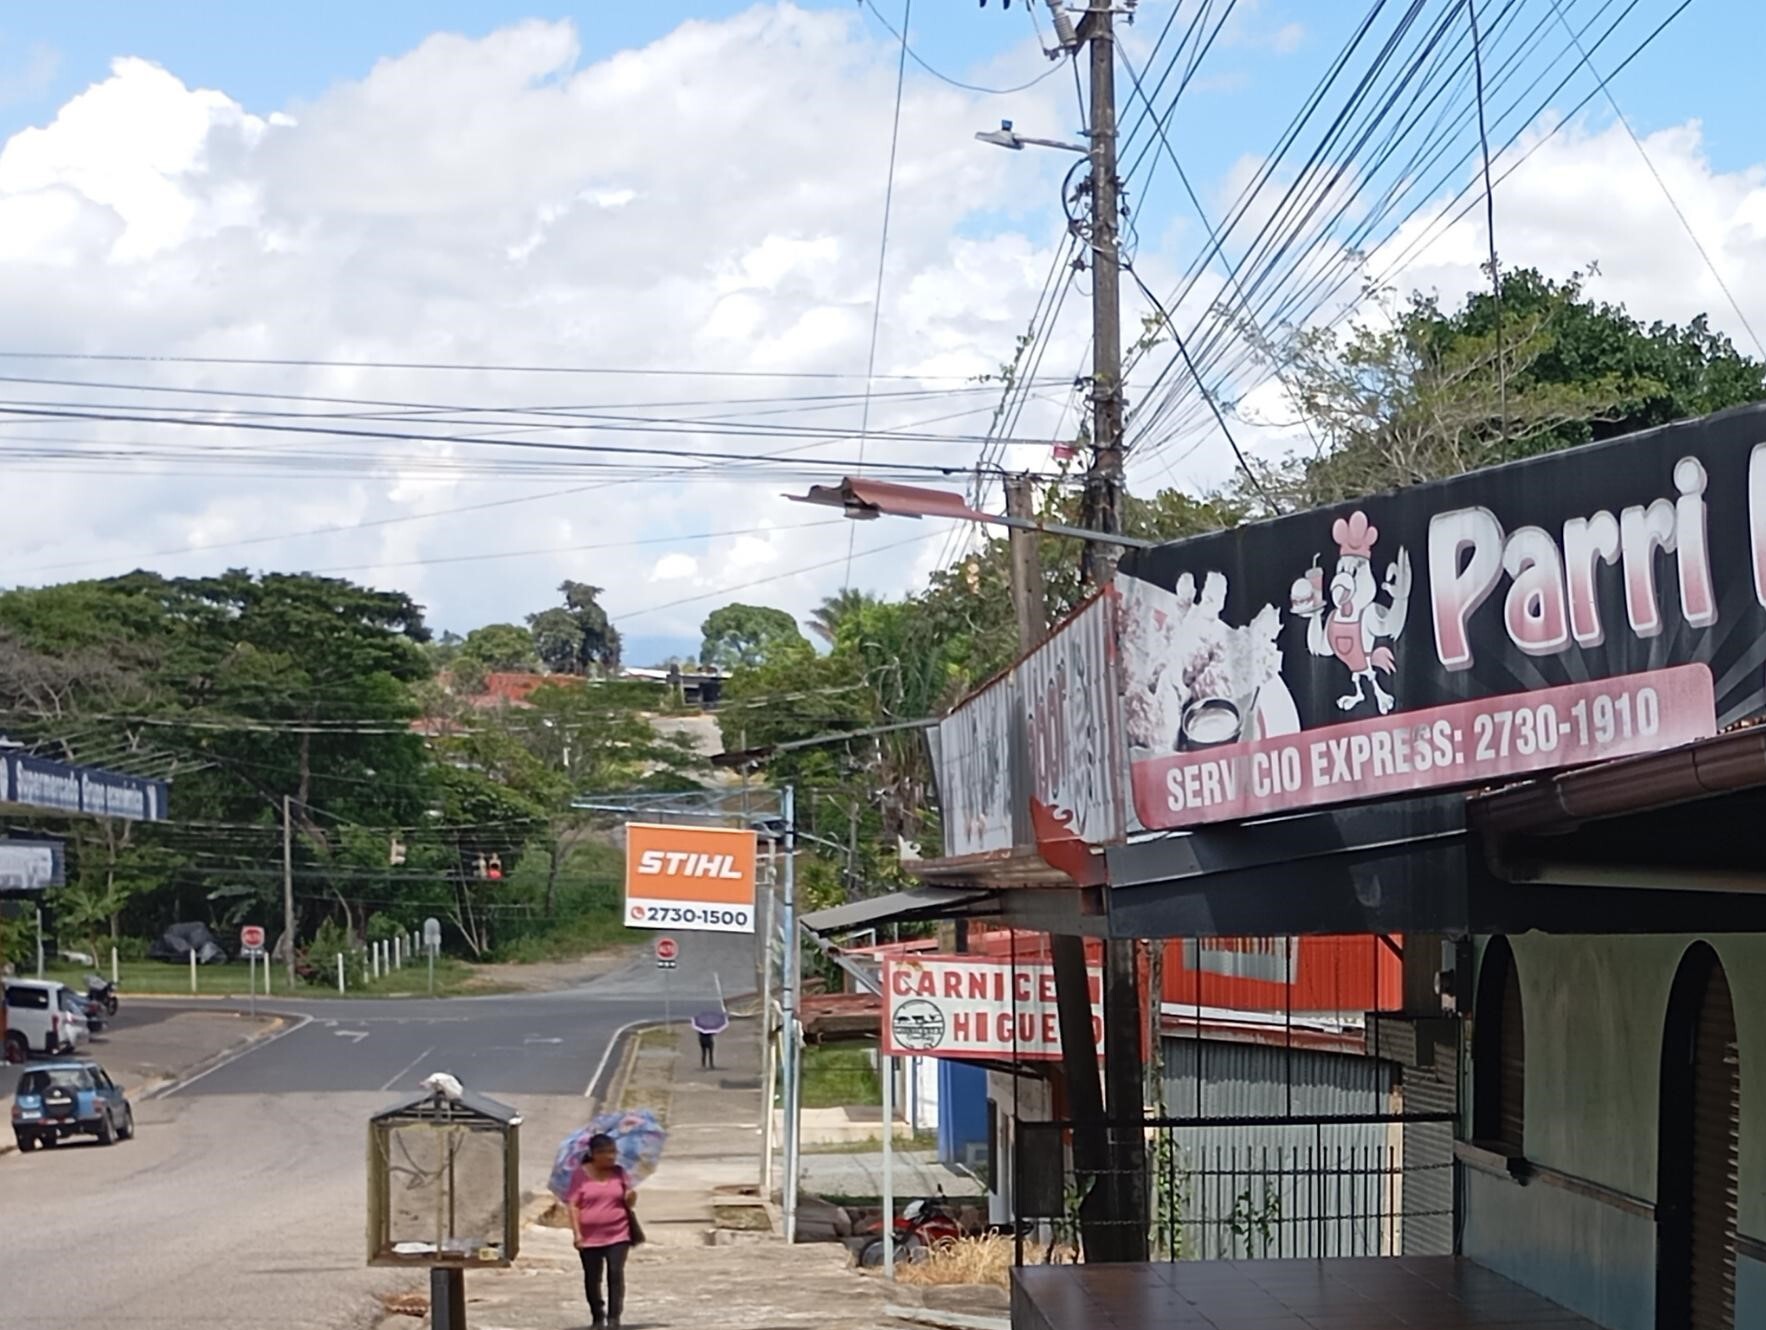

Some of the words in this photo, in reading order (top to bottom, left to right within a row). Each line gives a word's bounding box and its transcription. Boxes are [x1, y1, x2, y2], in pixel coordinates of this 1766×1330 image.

[1428, 456, 1718, 672] Parri
[1167, 746, 1302, 812] SERVCIO
[1310, 719, 1465, 788] EXPRESS:
[1474, 687, 1659, 763] 2730-1910
[637, 850, 743, 879] STIHL
[647, 907, 748, 926] 2730-1500
